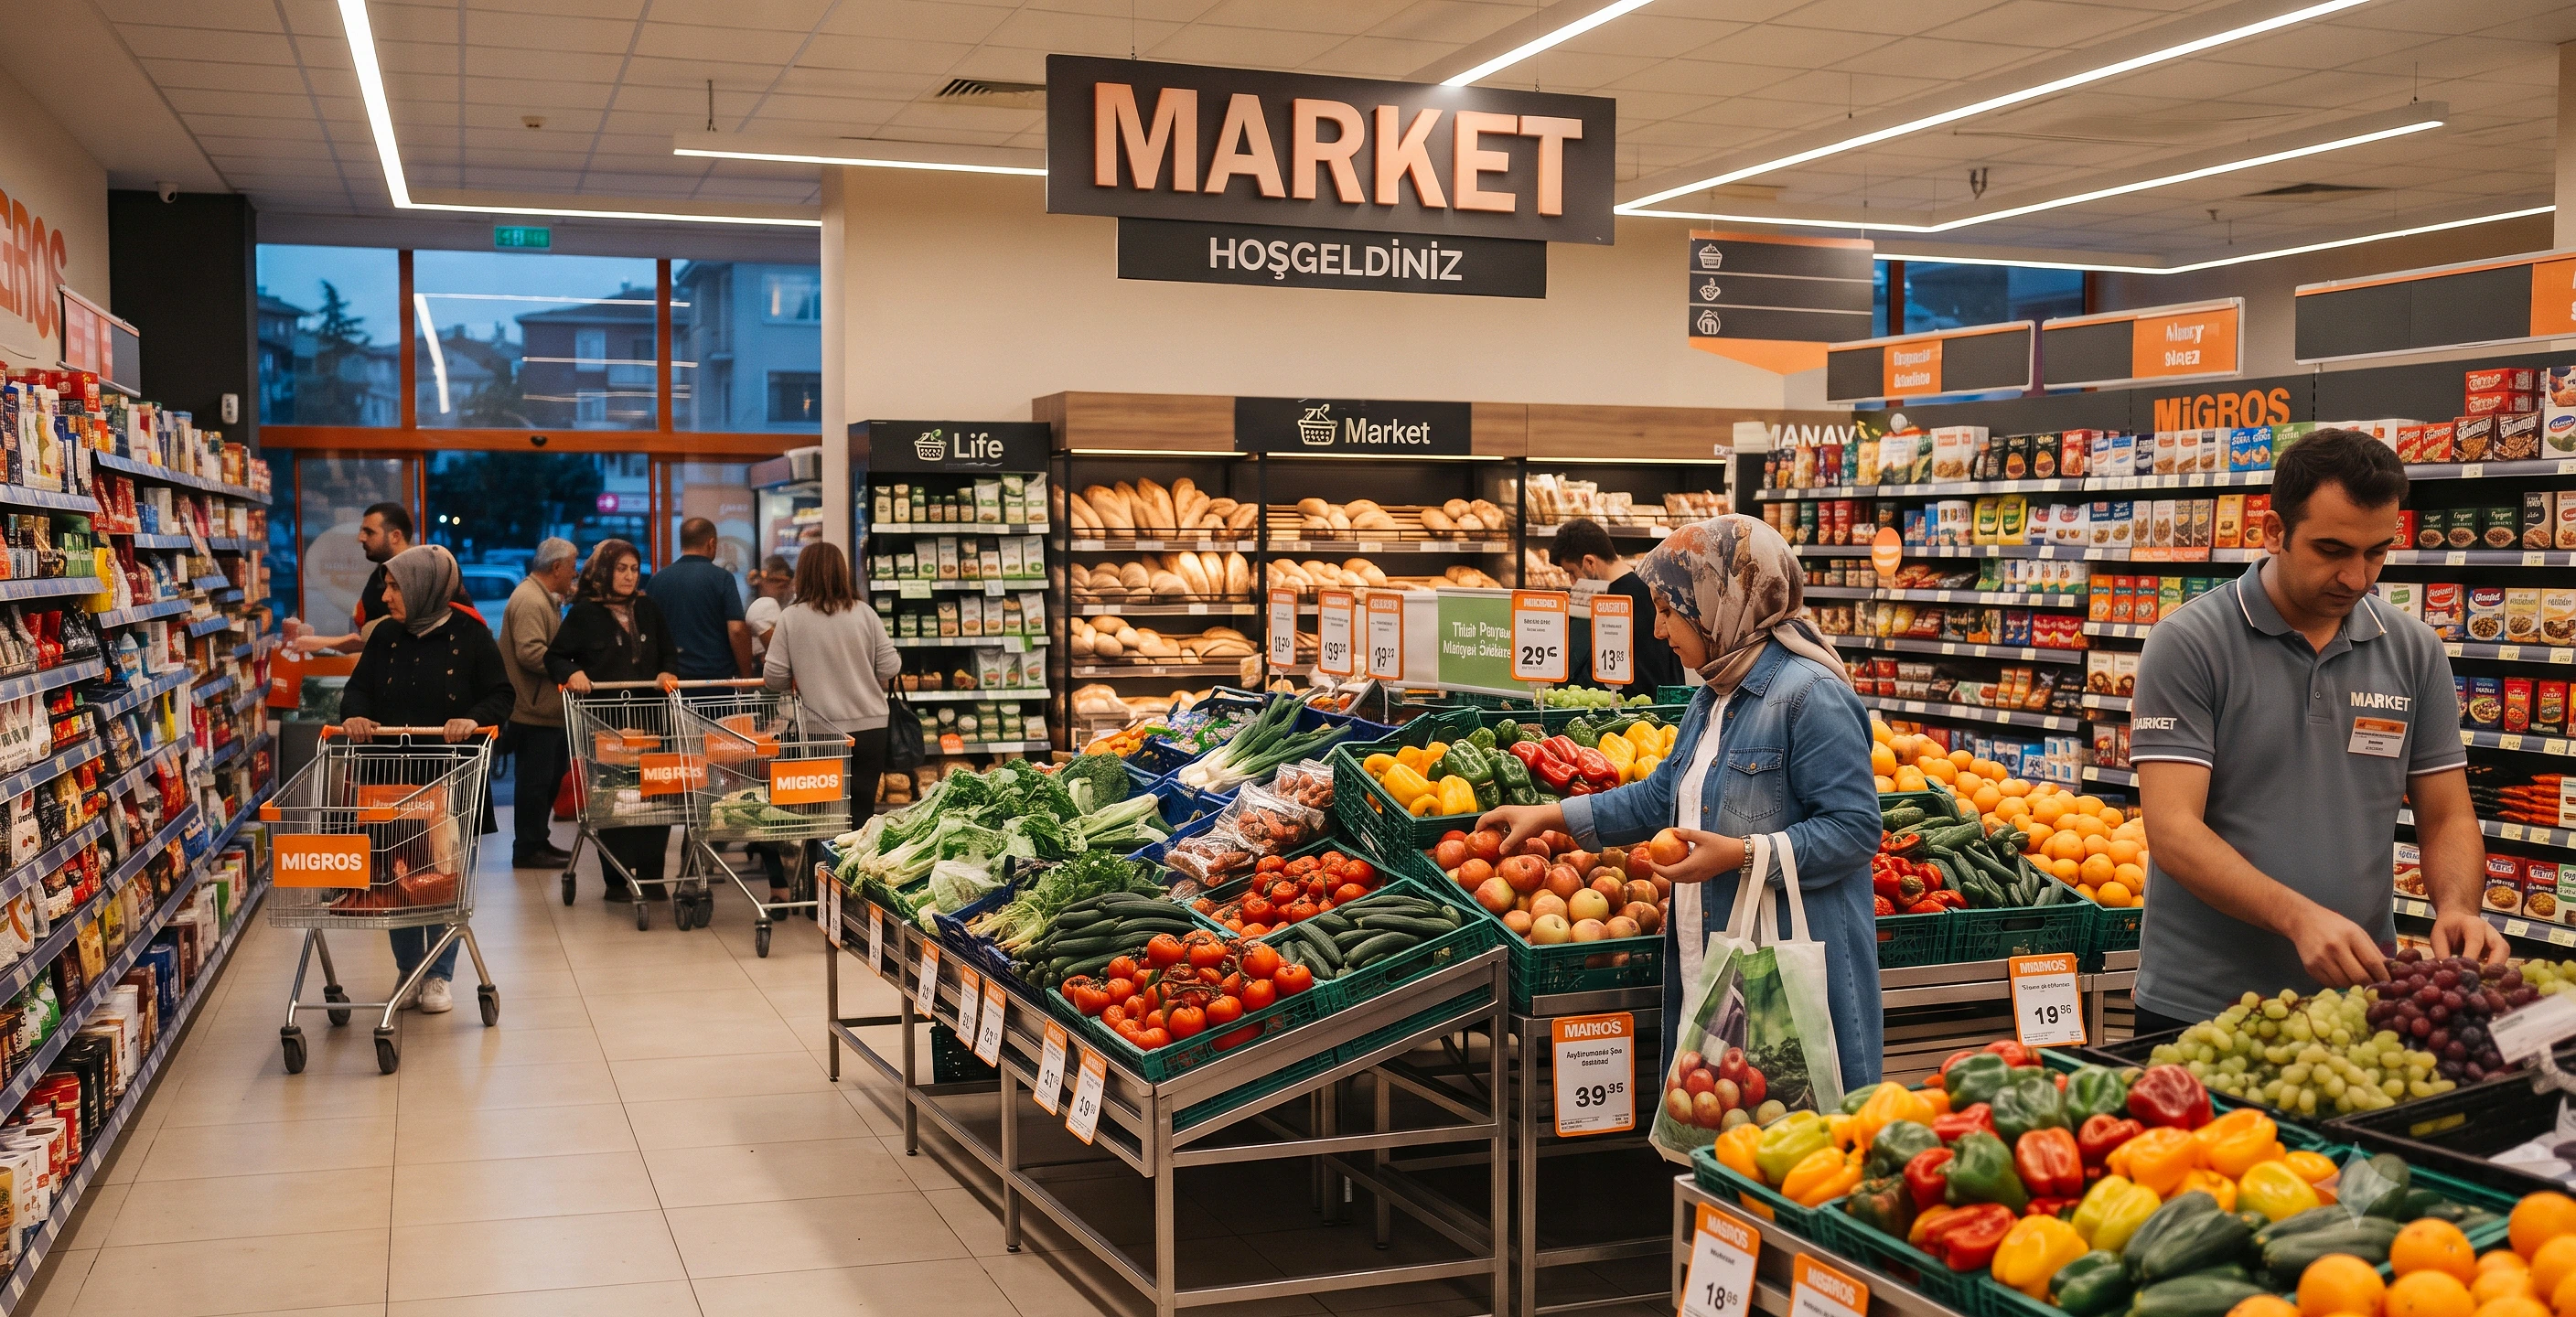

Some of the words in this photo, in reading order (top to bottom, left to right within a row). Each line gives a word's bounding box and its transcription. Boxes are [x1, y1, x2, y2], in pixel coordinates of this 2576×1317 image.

[1095, 81, 1583, 217] MARKET
[1209, 236, 1463, 281] HOŞGELDİNİZ
[1346, 416, 1431, 445] Market
[953, 433, 1004, 459] Life
[2350, 692, 2411, 712] MARKET
[777, 774, 839, 791] MIGROS
[282, 852, 362, 871] MIGROS
[2034, 1006, 2059, 1025] 19
[1706, 1281, 1726, 1311] 18
